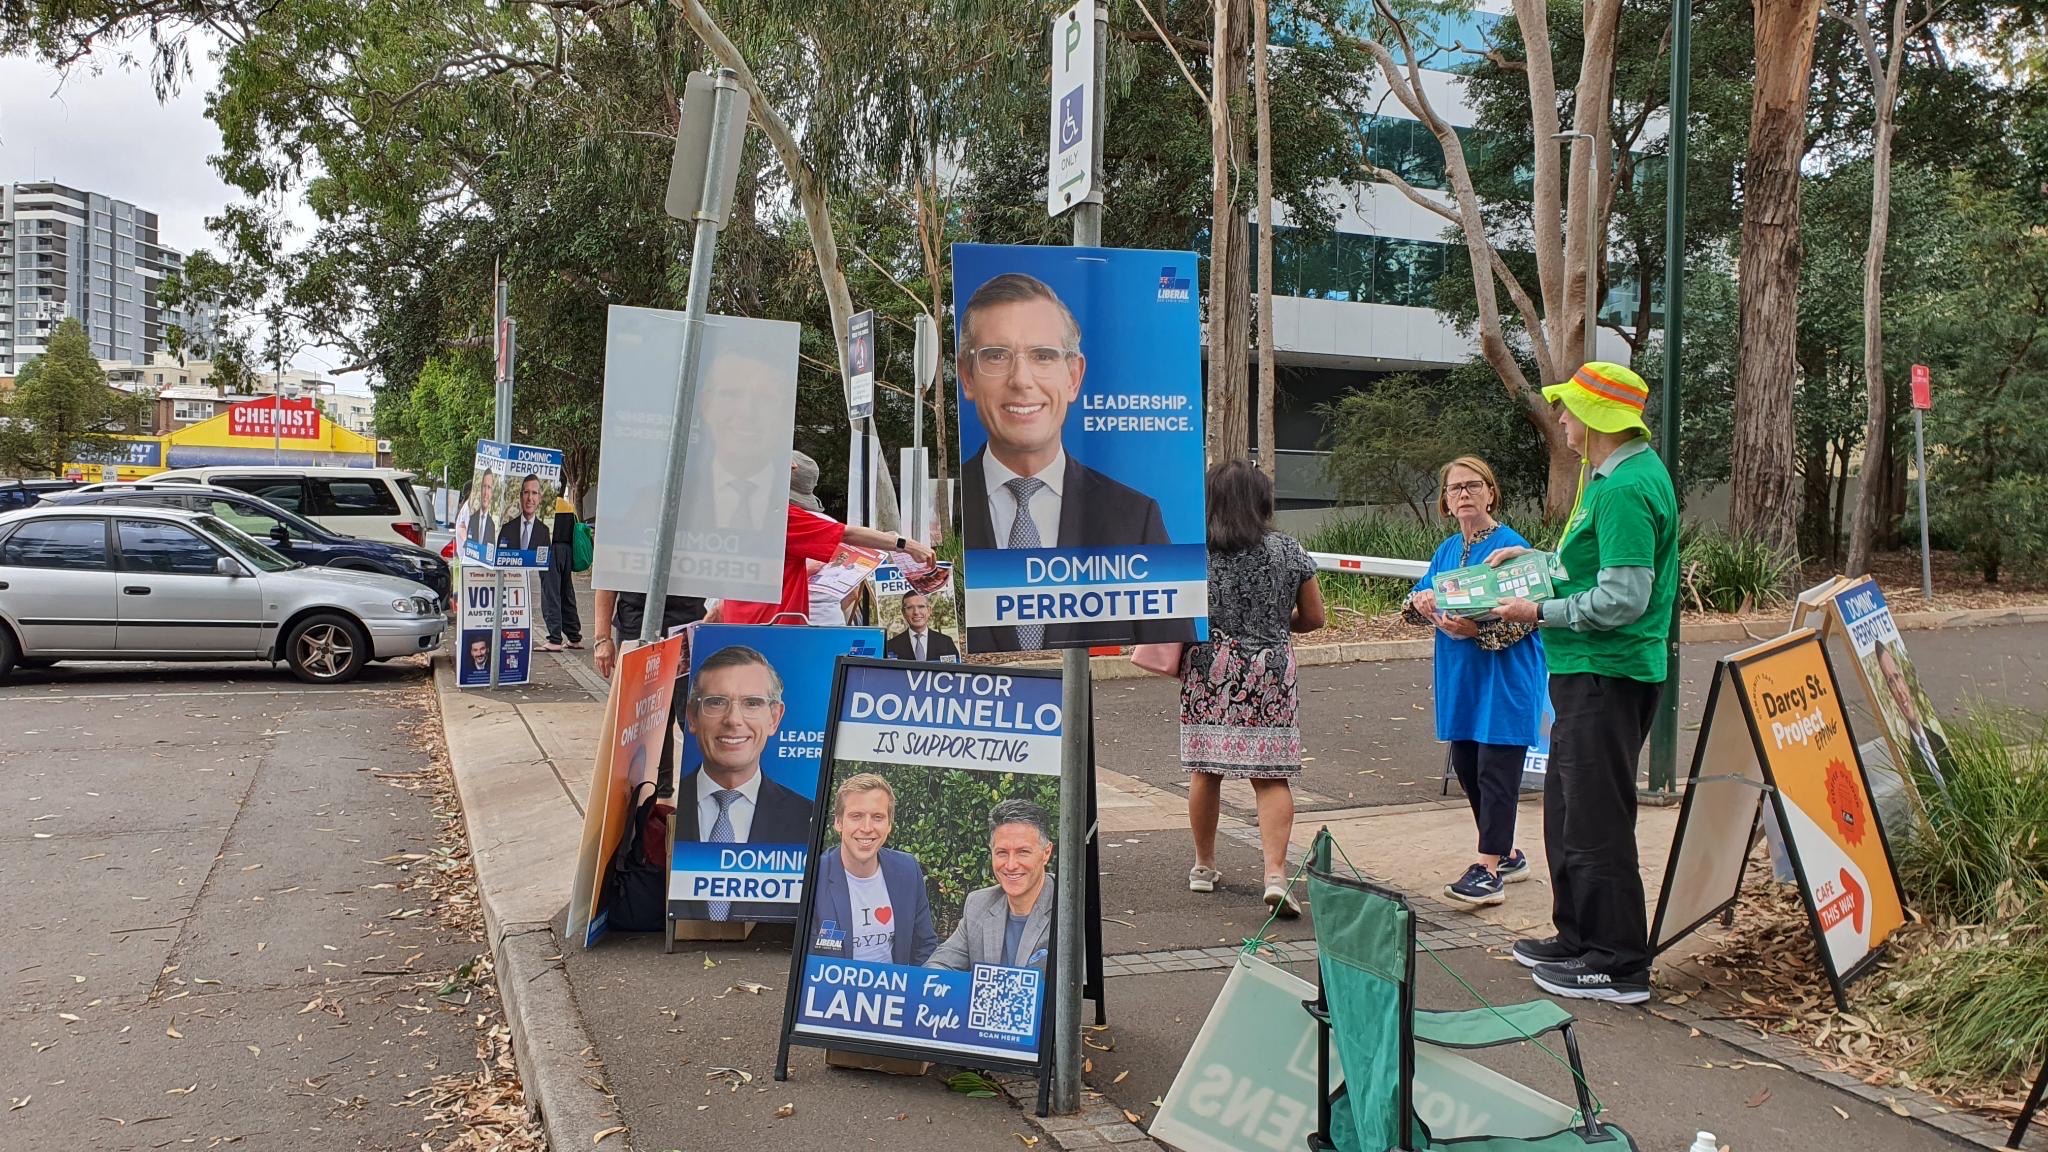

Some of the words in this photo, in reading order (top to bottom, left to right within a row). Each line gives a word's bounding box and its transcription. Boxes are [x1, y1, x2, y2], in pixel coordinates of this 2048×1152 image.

[1065, 20, 1082, 73] P
[1060, 151, 1079, 171] ONLY
[1157, 288, 1189, 300] LIBERAL
[1083, 394, 1193, 410] LEADERSHIP.
[234, 406, 315, 427] CHEMIST
[1083, 416, 1194, 432] EXPERIENCE.
[518, 449, 552, 463] DOMINIC
[510, 461, 560, 477] PERROTTET
[496, 557, 523, 566] EPPING
[1026, 554, 1149, 583] DOMINIC
[513, 589, 519, 606] 1
[996, 589, 1178, 621] PERROTTET
[906, 669, 1013, 697] VICTOR
[635, 693, 657, 719] VOTE
[1762, 685, 1808, 718] Darcy
[1805, 674, 1827, 700] St.
[850, 691, 1062, 731] DOMINELLO
[621, 722, 639, 746] ONE
[639, 707, 667, 735] NATION
[1771, 706, 1826, 750] Project
[1814, 718, 1838, 751] EPPING
[873, 730, 900, 754] IS
[903, 731, 1029, 763] SUPPORTING
[1815, 880, 1835, 904] CAFE
[861, 907, 871, 927] I
[1821, 904, 1840, 928] THIS
[1838, 892, 1855, 915] WAY
[815, 938, 843, 948] LIBERAL
[810, 963, 908, 992] JORDAN
[922, 974, 952, 998] For
[1577, 973, 1612, 985] HOKA
[804, 986, 906, 1028] LANE
[915, 1003, 961, 1039] Ryde
[978, 1031, 999, 1040] SCAN
[1000, 1033, 1021, 1042] HERE
